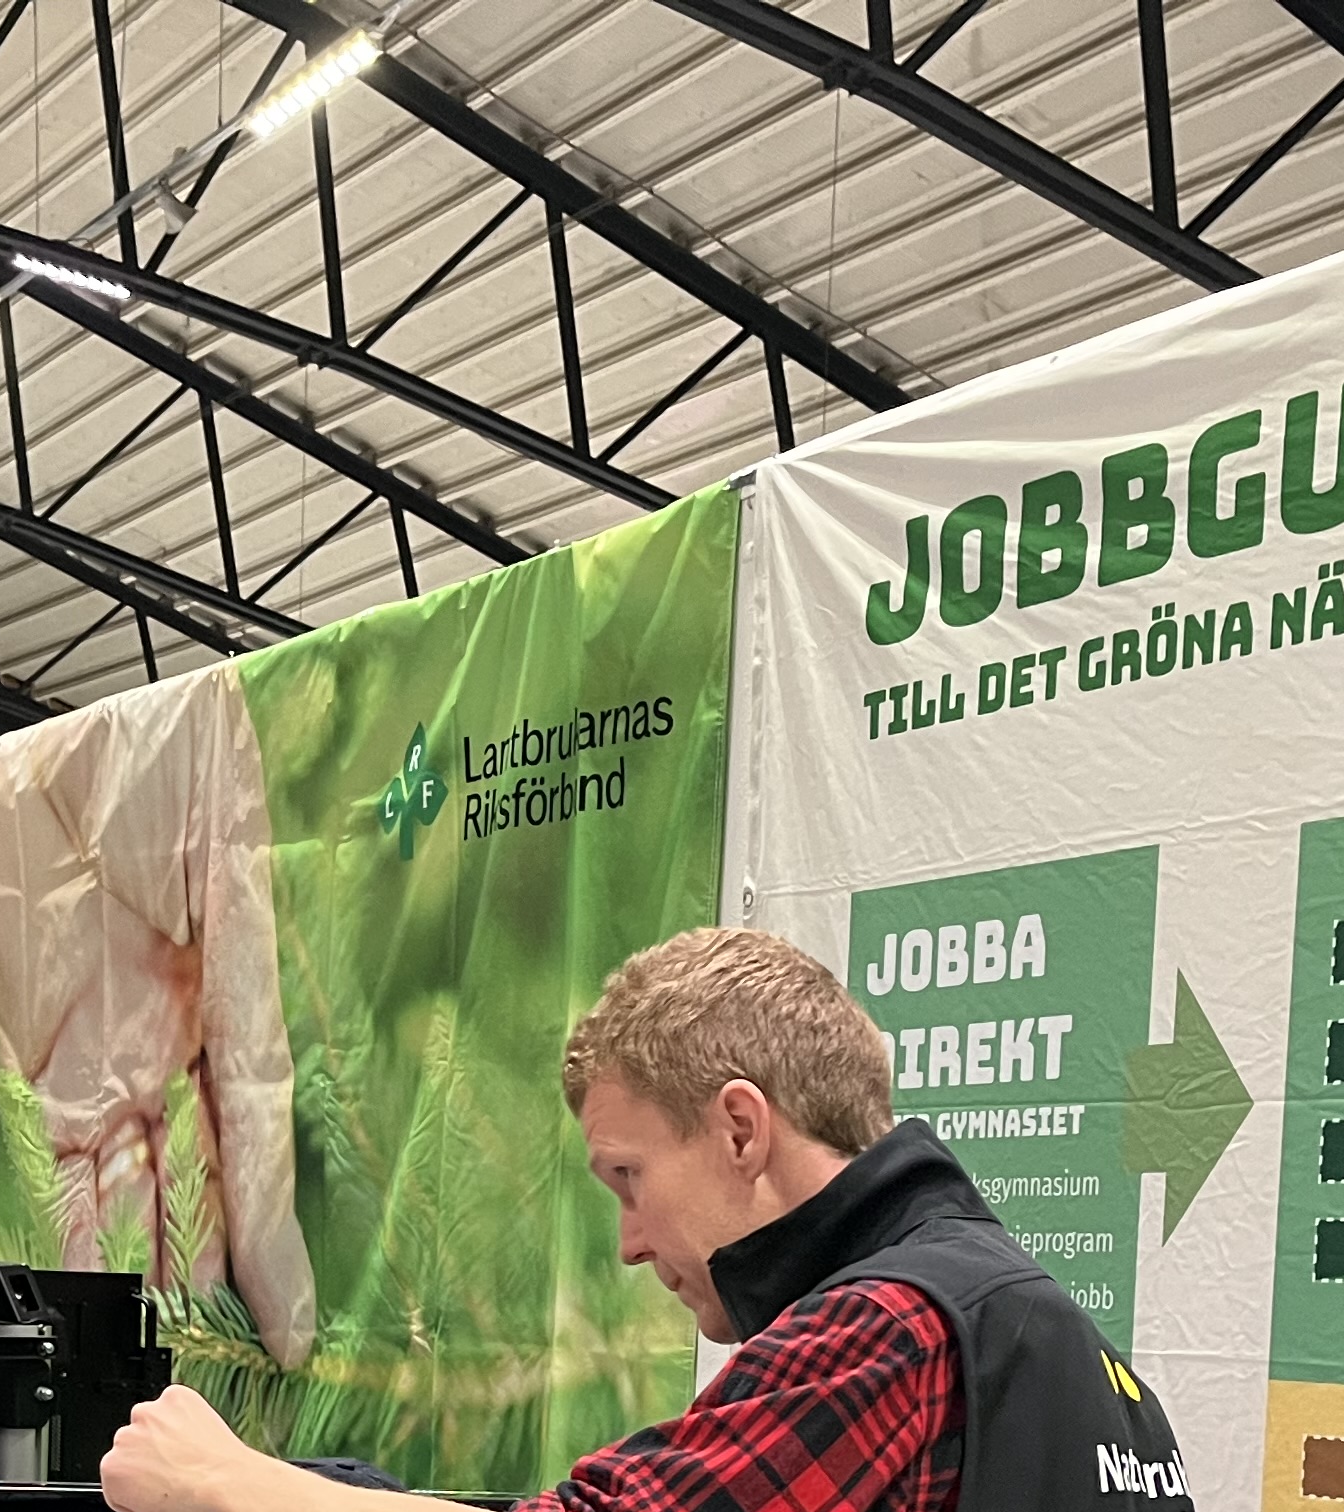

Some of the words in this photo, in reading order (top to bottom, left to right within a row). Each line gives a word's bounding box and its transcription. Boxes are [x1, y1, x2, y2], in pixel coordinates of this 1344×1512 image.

[864, 674, 965, 740] TILL
[978, 646, 1066, 715] DET
[1078, 602, 1253, 691] GRÖNA
[867, 914, 1045, 995] JOBBA
[937, 1105, 1085, 1140] GYMNASIET
[1008, 1225, 1113, 1260] ieprogram
